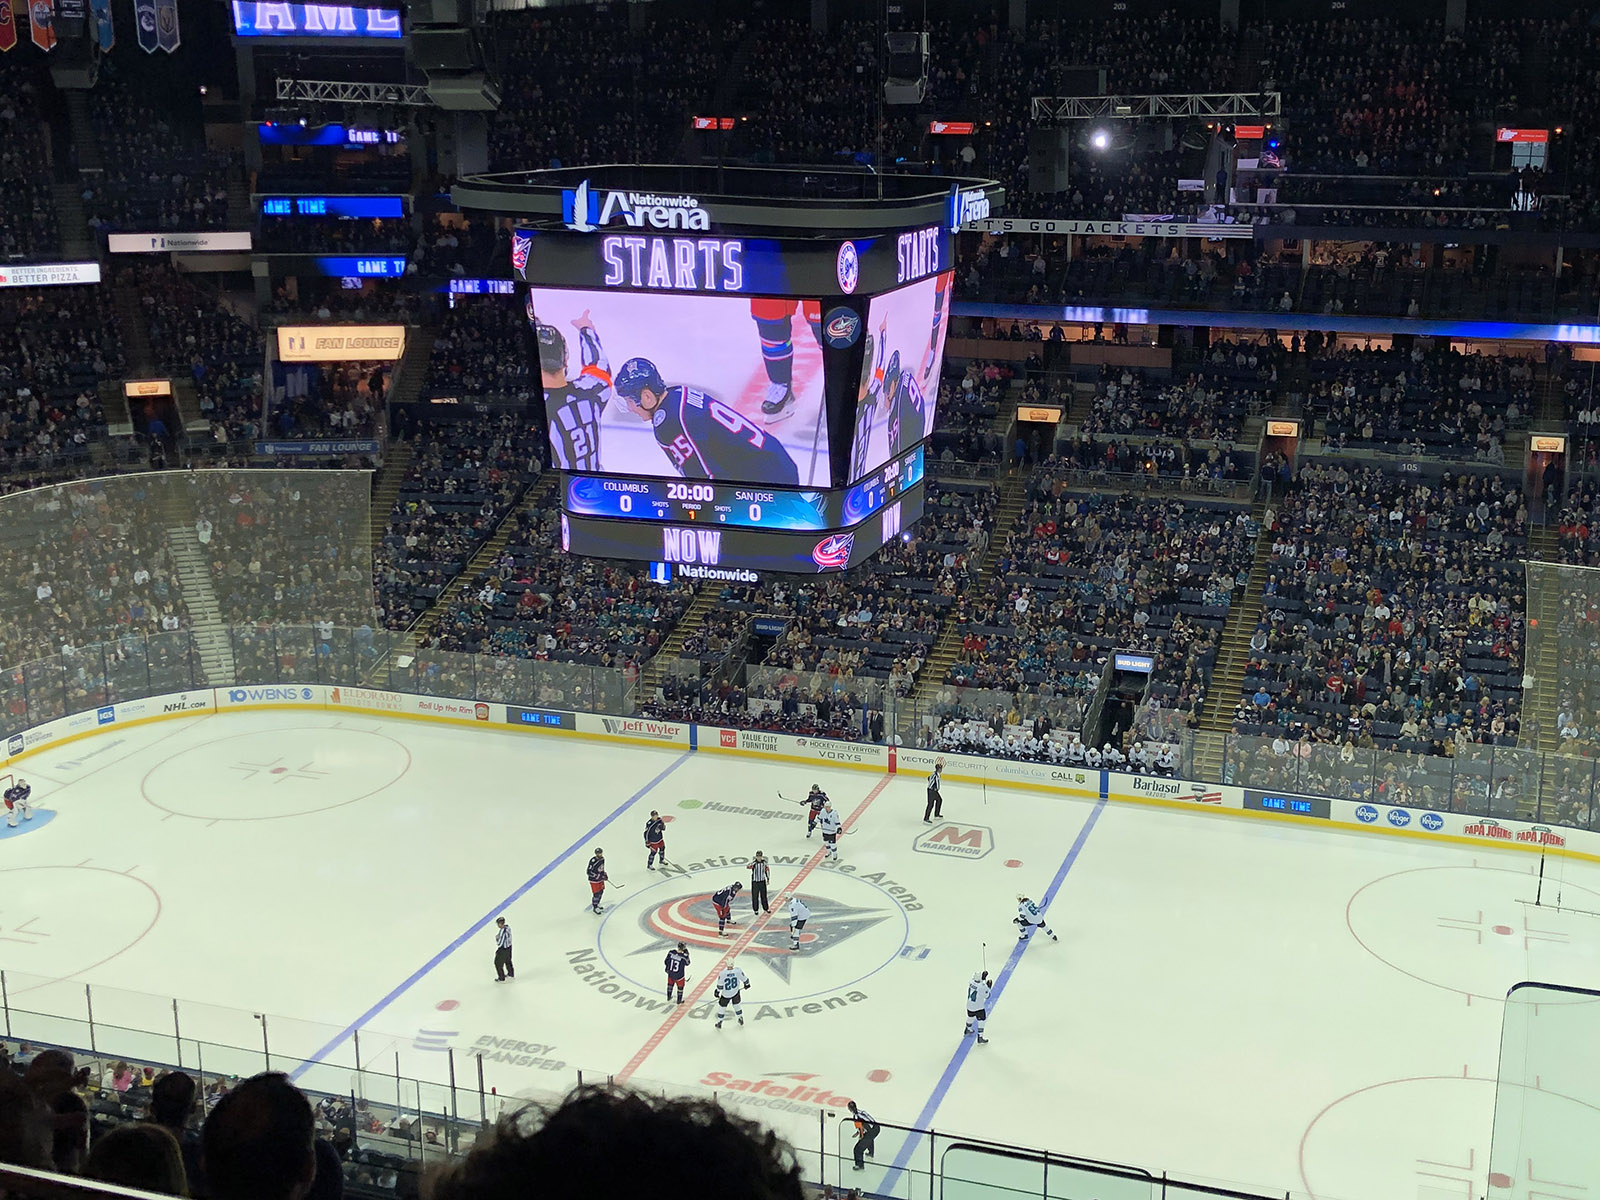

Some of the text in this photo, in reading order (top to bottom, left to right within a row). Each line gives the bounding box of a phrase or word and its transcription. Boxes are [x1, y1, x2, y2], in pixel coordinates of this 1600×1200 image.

[348, 129, 379, 142] GAME
[297, 200, 327, 214] TIME
[630, 192, 699, 208] Nationwide
[600, 191, 711, 231] Arena
[959, 191, 991, 225] Arena
[960, 219, 1180, 235] ET'S GO JACKETS
[166, 239, 209, 247] Nationwide
[897, 226, 940, 284] STARTS
[357, 261, 388, 274] GAME
[603, 236, 743, 291] STARTS
[12, 274, 49, 283] BETTER
[449, 279, 515, 294] GAME TIME
[315, 337, 400, 350] FAN LOUNGE
[474, 405, 489, 413] 101
[308, 443, 332, 452] FAN
[331, 442, 373, 452] LOUNGE
[570, 423, 596, 459] 21
[1402, 462, 1418, 472] 105
[603, 481, 650, 494] COLUMBUS
[666, 483, 714, 502] 20:00
[619, 494, 633, 513] 0
[651, 500, 670, 508] SHOTS
[735, 491, 775, 503] SAN JOSE
[657, 509, 664, 518] 0
[681, 502, 702, 511] PERIOD
[714, 504, 732, 513] SHOTS
[748, 503, 762, 522] 0
[719, 514, 726, 522] 0
[882, 500, 902, 545] NOW
[663, 527, 722, 565] NOW
[678, 563, 759, 584] Nationwide
[1117, 659, 1151, 668] BUD LIGHT
[229, 688, 298, 703] 10 WBNS
[343, 688, 402, 703] ELDORADO
[163, 701, 206, 713] NHL.COM
[418, 701, 474, 716] Roll Up the Rim
[99, 711, 115, 720] IGS
[521, 712, 561, 726] GAME TIME
[622, 720, 681, 737] Jeff Wyler
[720, 734, 737, 743] VCF
[742, 733, 779, 744] VALUE CITY
[742, 741, 778, 752] FURNITURE
[809, 741, 835, 749] HOCKEY
[847, 746, 881, 755] EVERYONE
[818, 750, 862, 762] VORYS
[901, 755, 989, 771] VECTOR SECURITY
[995, 765, 1030, 777] Columbia
[1051, 771, 1074, 781] CALL
[1132, 777, 1181, 795] Barbasol
[703, 801, 806, 822] Huntington
[1262, 797, 1311, 813] GAME TIME
[1355, 806, 1379, 822] Kroger
[1388, 810, 1411, 826] Kroger
[1420, 814, 1444, 831] Kroger
[1464, 824, 1514, 841] PAPA JOHNS
[1516, 831, 1538, 843] PAPA
[920, 841, 982, 856] MARATHON
[860, 867, 925, 912] Arena
[669, 959, 680, 973] 13
[724, 977, 739, 991] 28
[753, 987, 869, 1022] Arena
[474, 1035, 557, 1058] ENERGY
[466, 1046, 567, 1073] TRANSFER
[700, 1072, 853, 1108] Safelite
